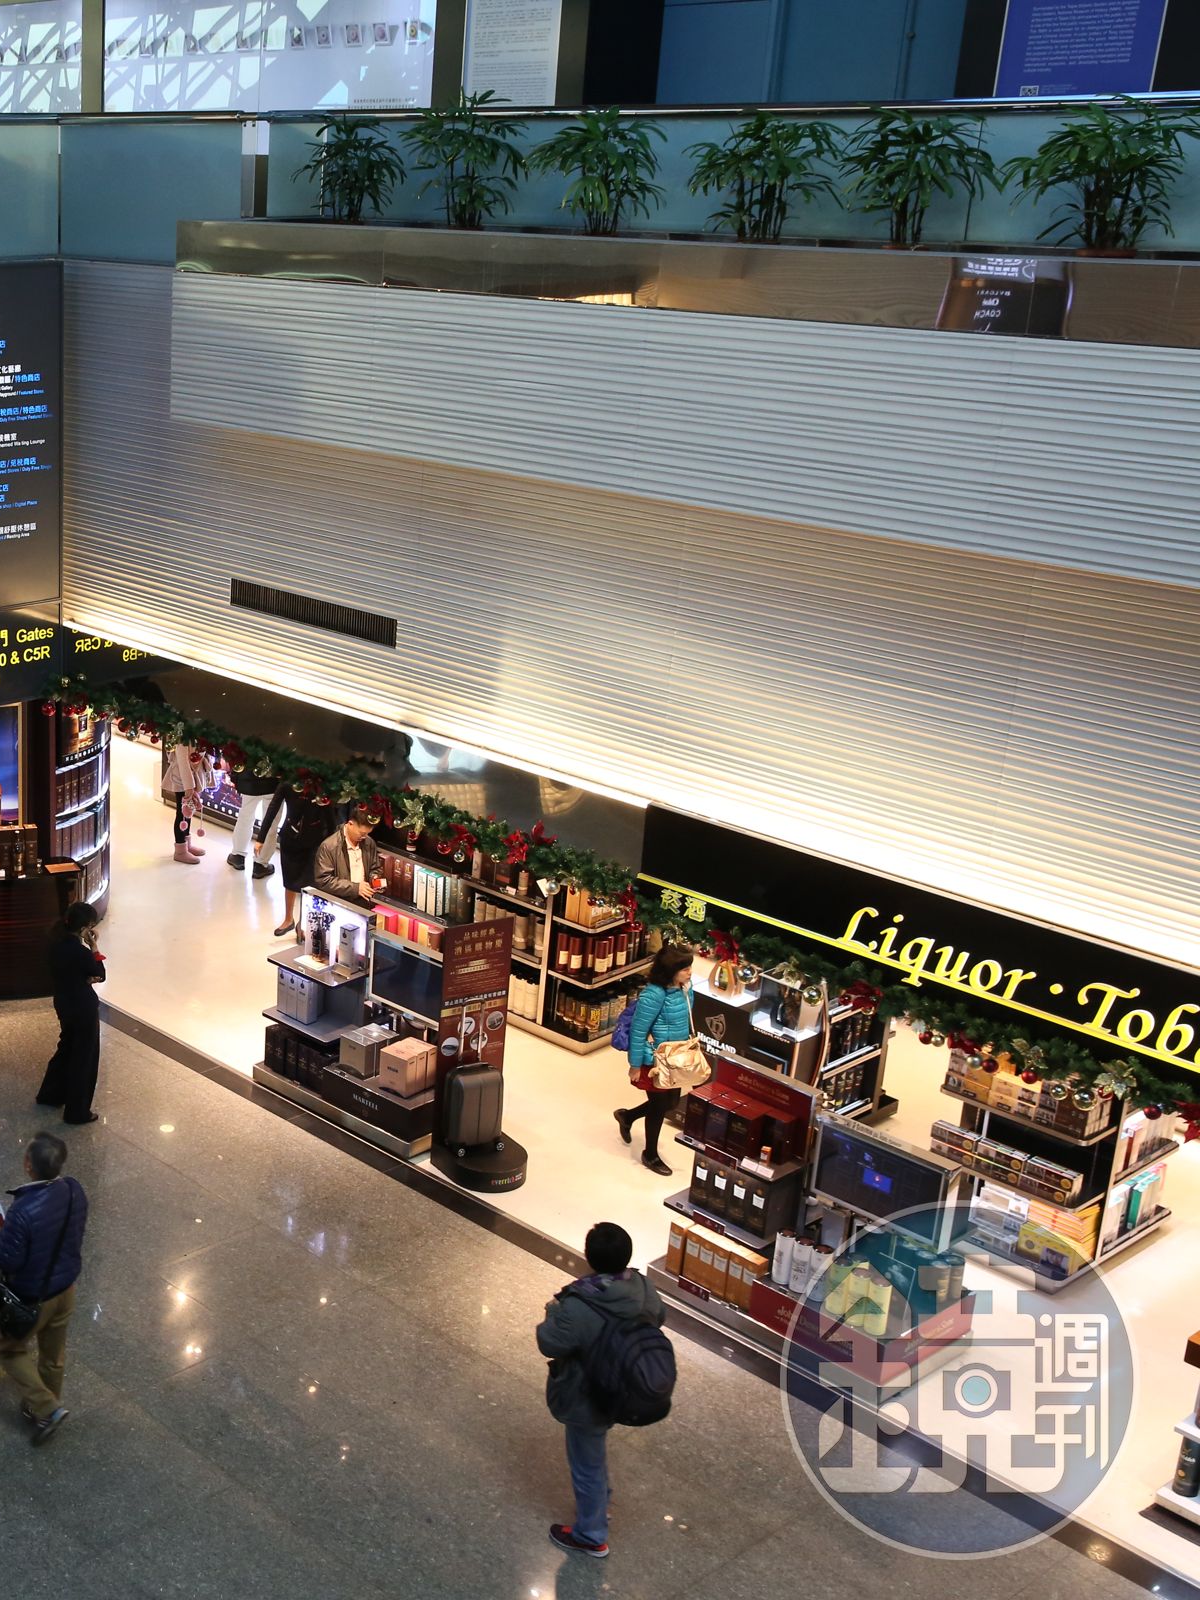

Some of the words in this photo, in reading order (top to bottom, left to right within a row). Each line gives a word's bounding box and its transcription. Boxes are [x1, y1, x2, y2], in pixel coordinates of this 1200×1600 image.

[16, 627, 54, 643] Gates
[10, 651, 20, 665] &
[23, 646, 50, 662] C5R
[660, 888, 706, 922] 菸酒
[836, 906, 1036, 1001] Liquor
[1078, 981, 1200, 1064] Tob
[697, 1032, 736, 1054] HIGHLAND
[706, 1044, 720, 1056] PAR
[353, 1093, 378, 1110] MARTELL
